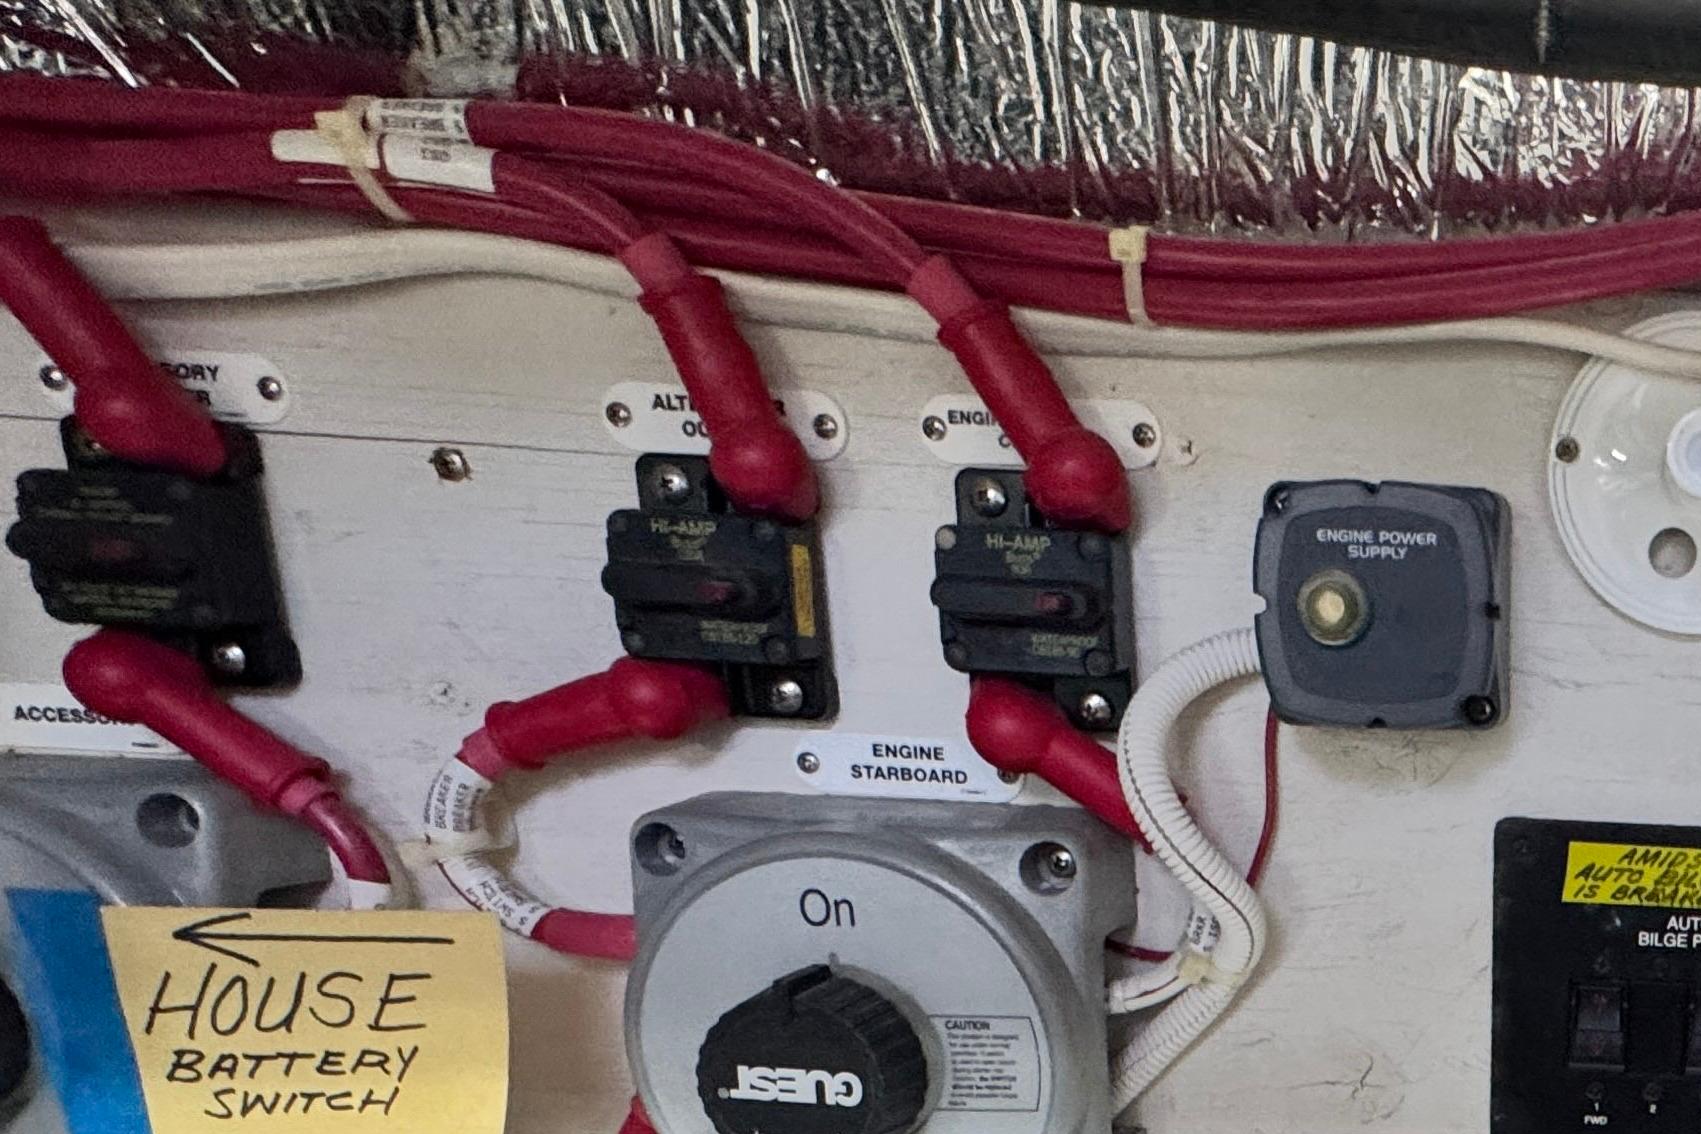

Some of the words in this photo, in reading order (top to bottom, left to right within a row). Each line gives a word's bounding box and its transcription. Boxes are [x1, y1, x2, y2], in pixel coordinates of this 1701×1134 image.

[948, 409, 1001, 427] ENGI
[986, 533, 1051, 551] HI-AMP
[1316, 528, 1374, 544] ENGINE
[1378, 530, 1438, 546] POWER
[1347, 546, 1409, 560] SUPPLY
[871, 743, 945, 761] ENGINE
[850, 764, 969, 785] STARBOARD
[1573, 862, 1645, 884] AUTO
[1573, 884, 1601, 899] IS
[800, 888, 857, 928] On
[1638, 931, 1688, 948] BILGE
[144, 963, 433, 1041] HOUSE
[944, 1020, 990, 1031] CAUTION
[166, 1045, 419, 1084] BATTERY
[729, 1064, 864, 1108] GUEST
[204, 1085, 401, 1120] SWITCH
[1593, 1102, 1600, 1112] 1
[1649, 1104, 1657, 1114] 2
[1583, 1115, 1608, 1126] FWD
